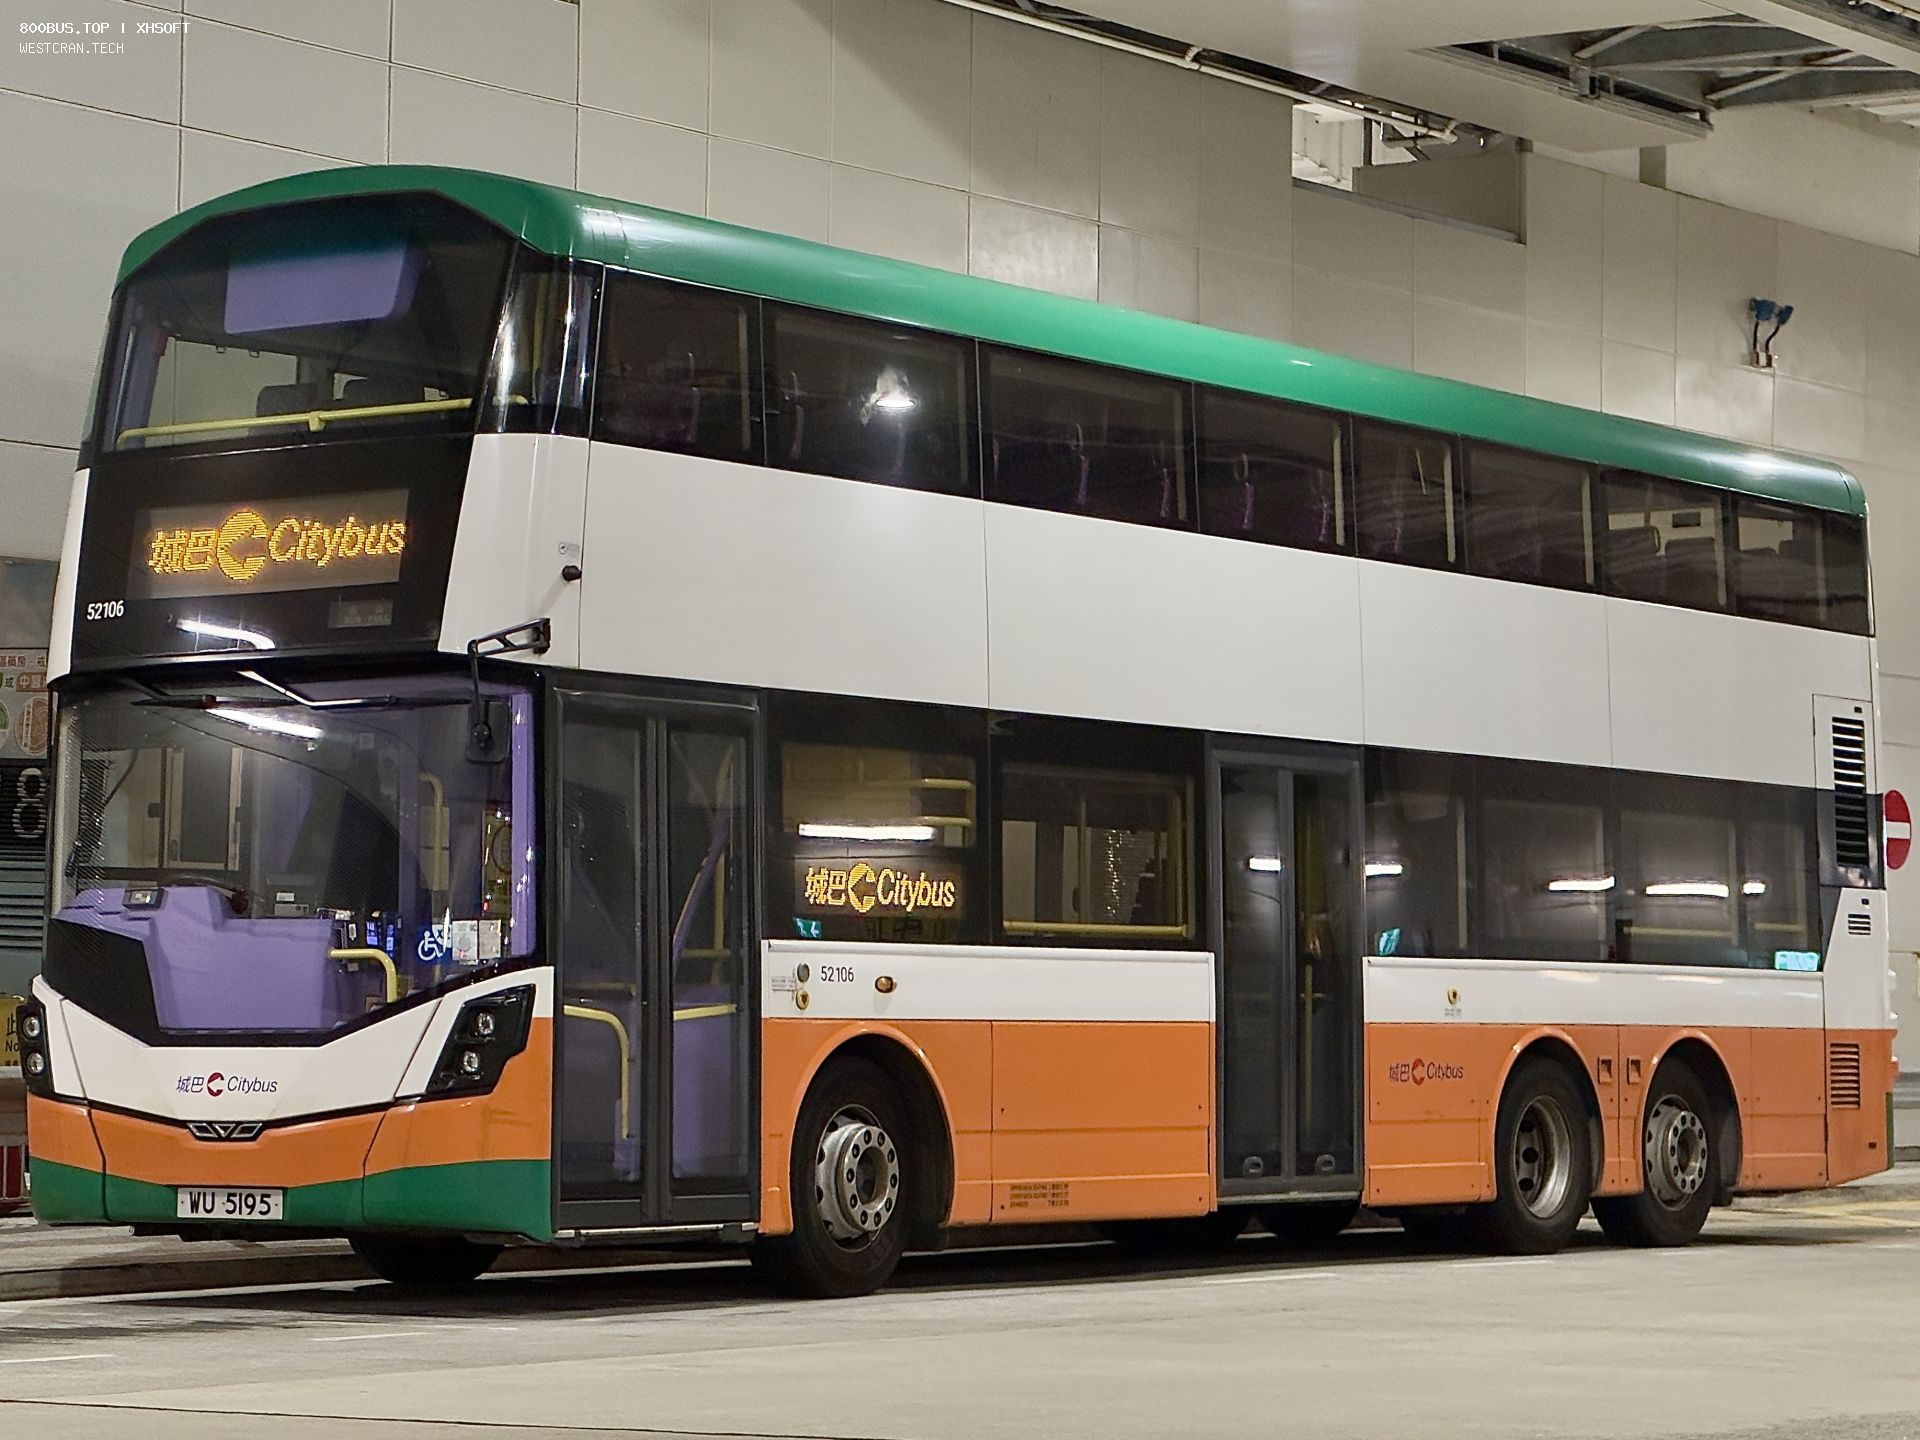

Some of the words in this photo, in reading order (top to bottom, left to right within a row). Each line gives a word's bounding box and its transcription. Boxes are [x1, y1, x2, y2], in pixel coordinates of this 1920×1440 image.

[149, 530, 217, 574] 城巴
[268, 516, 406, 569] Citybus
[87, 600, 125, 620] 52106
[804, 866, 848, 906] 城巴
[877, 868, 955, 912] Citybus
[820, 965, 855, 983] 52106
[1388, 1063, 1410, 1083] 城巴
[1426, 1061, 1464, 1081] Citybus
[176, 1076, 205, 1093] 城巴
[227, 1076, 278, 1094] Citybus
[189, 1191, 216, 1214] WU
[225, 1192, 272, 1216] 5195
